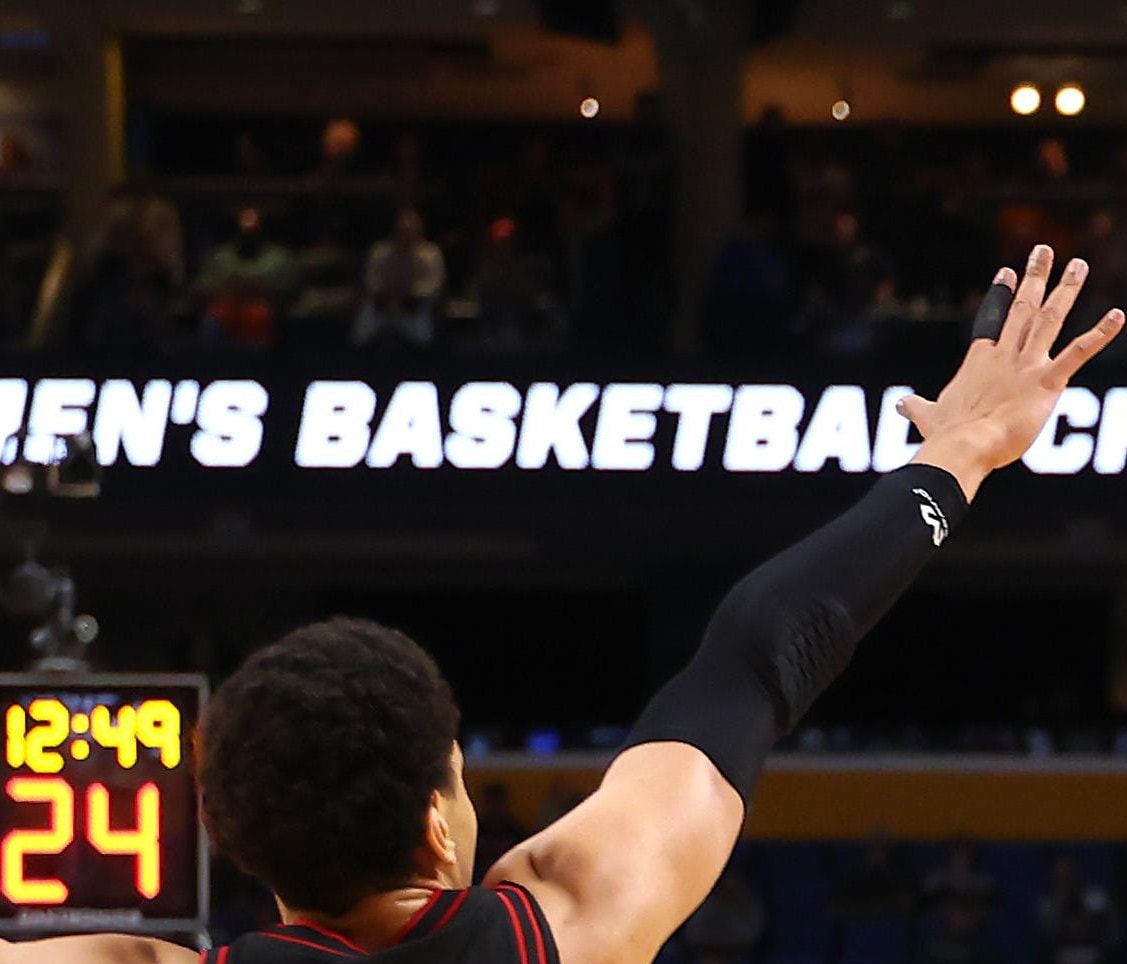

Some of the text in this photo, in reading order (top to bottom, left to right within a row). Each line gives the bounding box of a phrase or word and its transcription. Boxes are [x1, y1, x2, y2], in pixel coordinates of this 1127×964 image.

[294, 380, 926, 473] BASKETBAL
[6, 698, 181, 774] 12:49
[1, 776, 161, 905] 24
